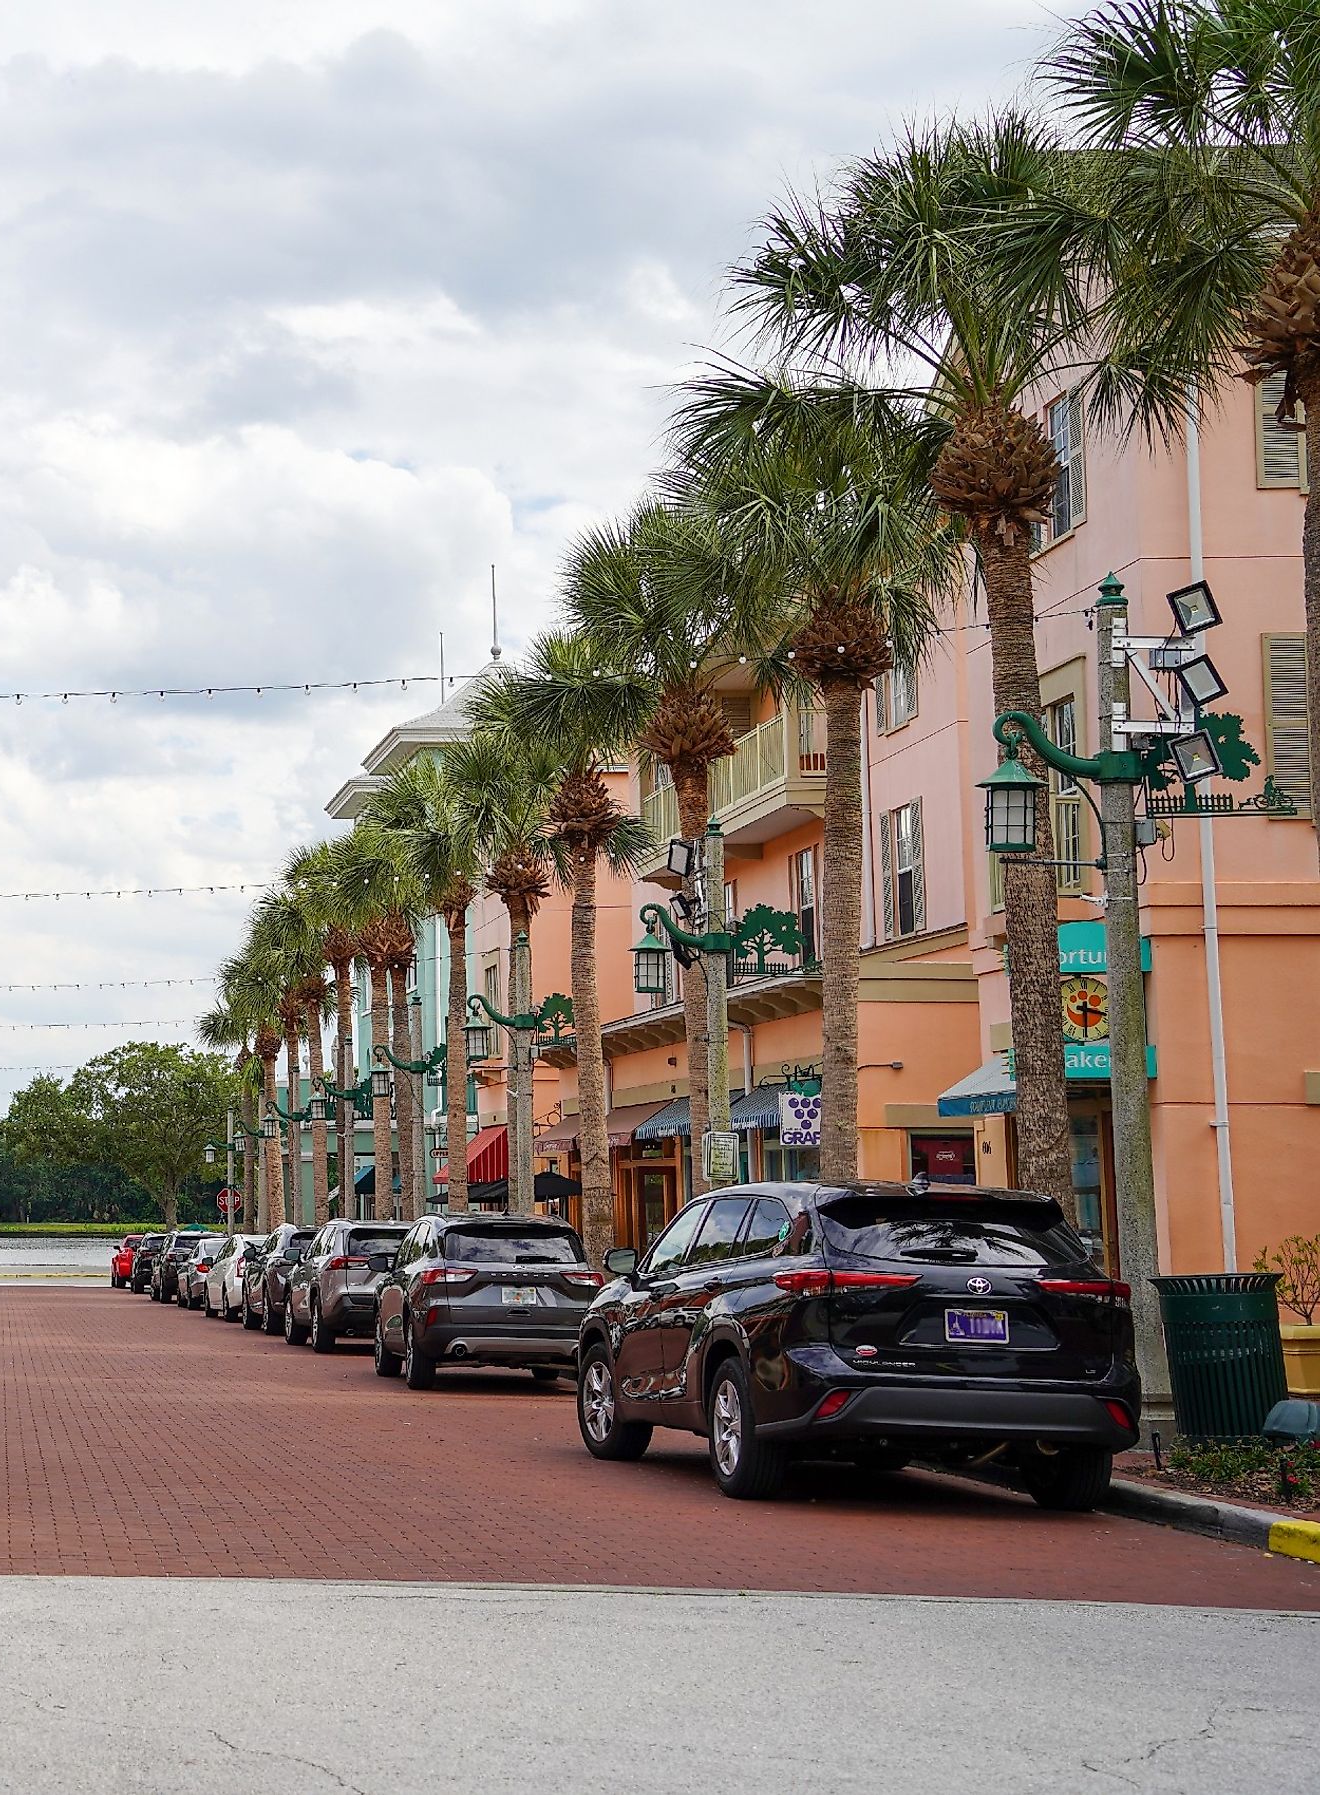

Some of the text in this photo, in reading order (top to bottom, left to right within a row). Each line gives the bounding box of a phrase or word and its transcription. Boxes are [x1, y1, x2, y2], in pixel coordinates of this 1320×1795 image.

[1059, 948, 1108, 965] ortu
[1066, 1051, 1111, 1069] ake
[218, 1196, 240, 1205] STP
